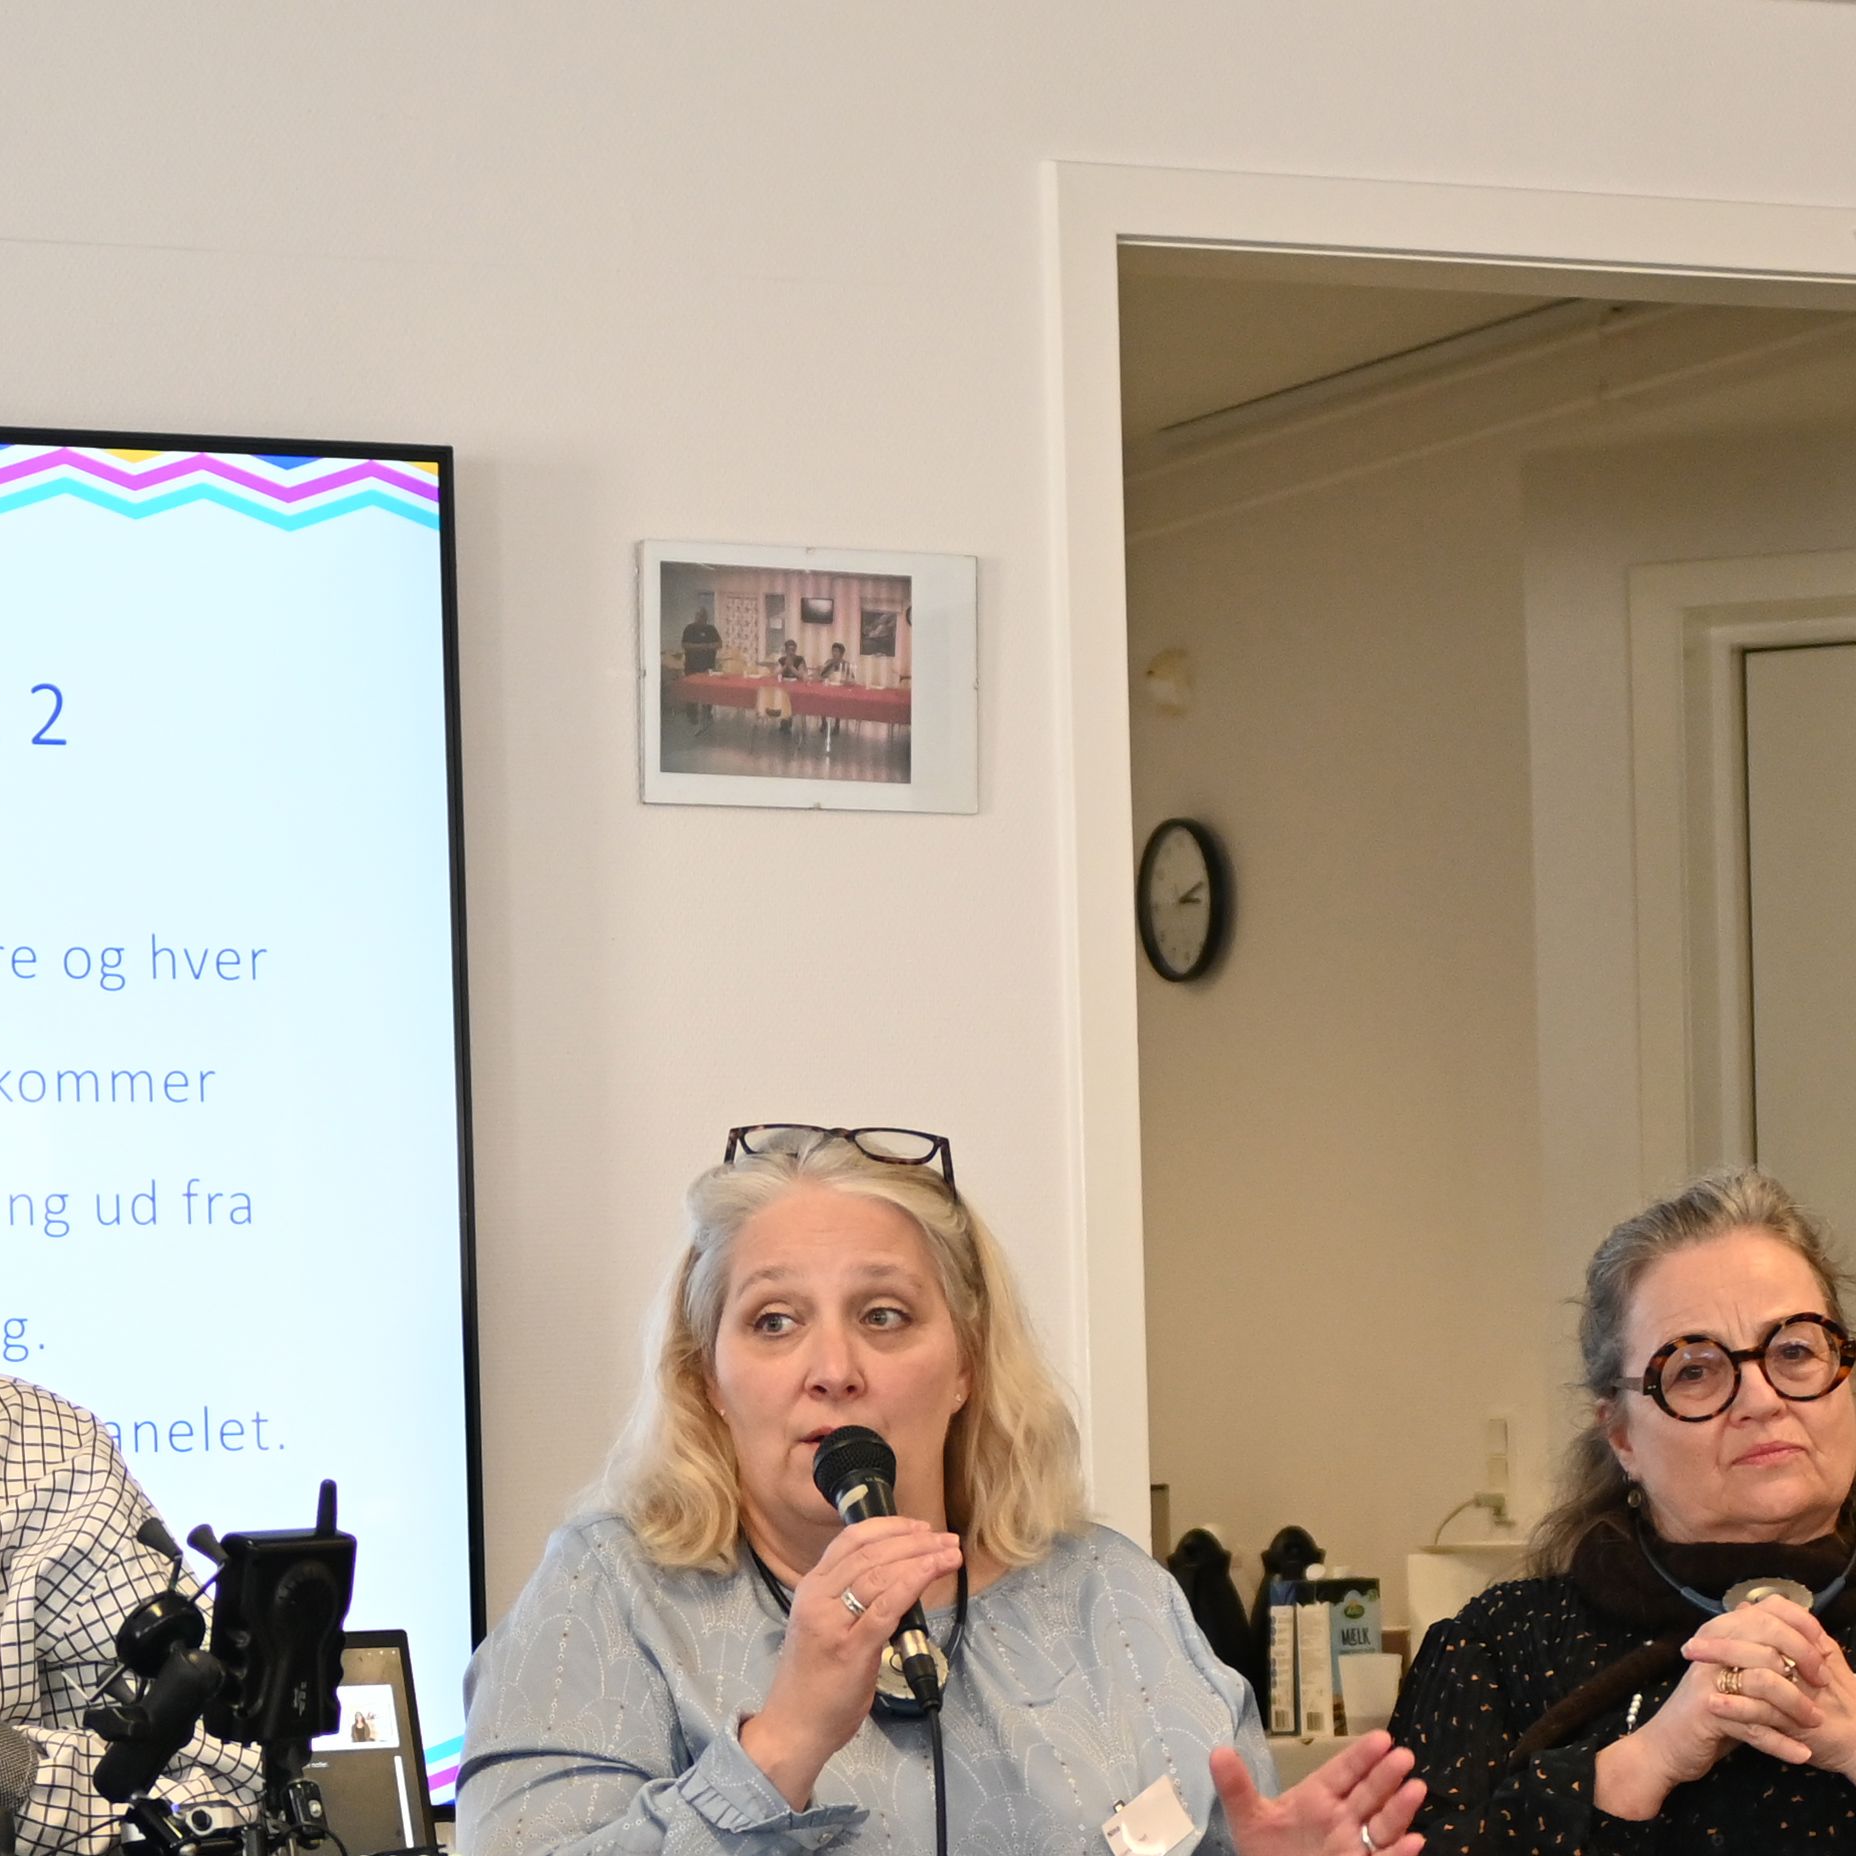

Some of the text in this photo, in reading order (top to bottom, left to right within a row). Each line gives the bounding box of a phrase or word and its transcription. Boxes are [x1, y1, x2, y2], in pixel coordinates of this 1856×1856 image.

[31, 683, 69, 748] 2
[64, 947, 128, 994] og
[152, 933, 269, 983] hver
[96, 1179, 158, 1228] ud
[182, 1178, 253, 1227] fra
